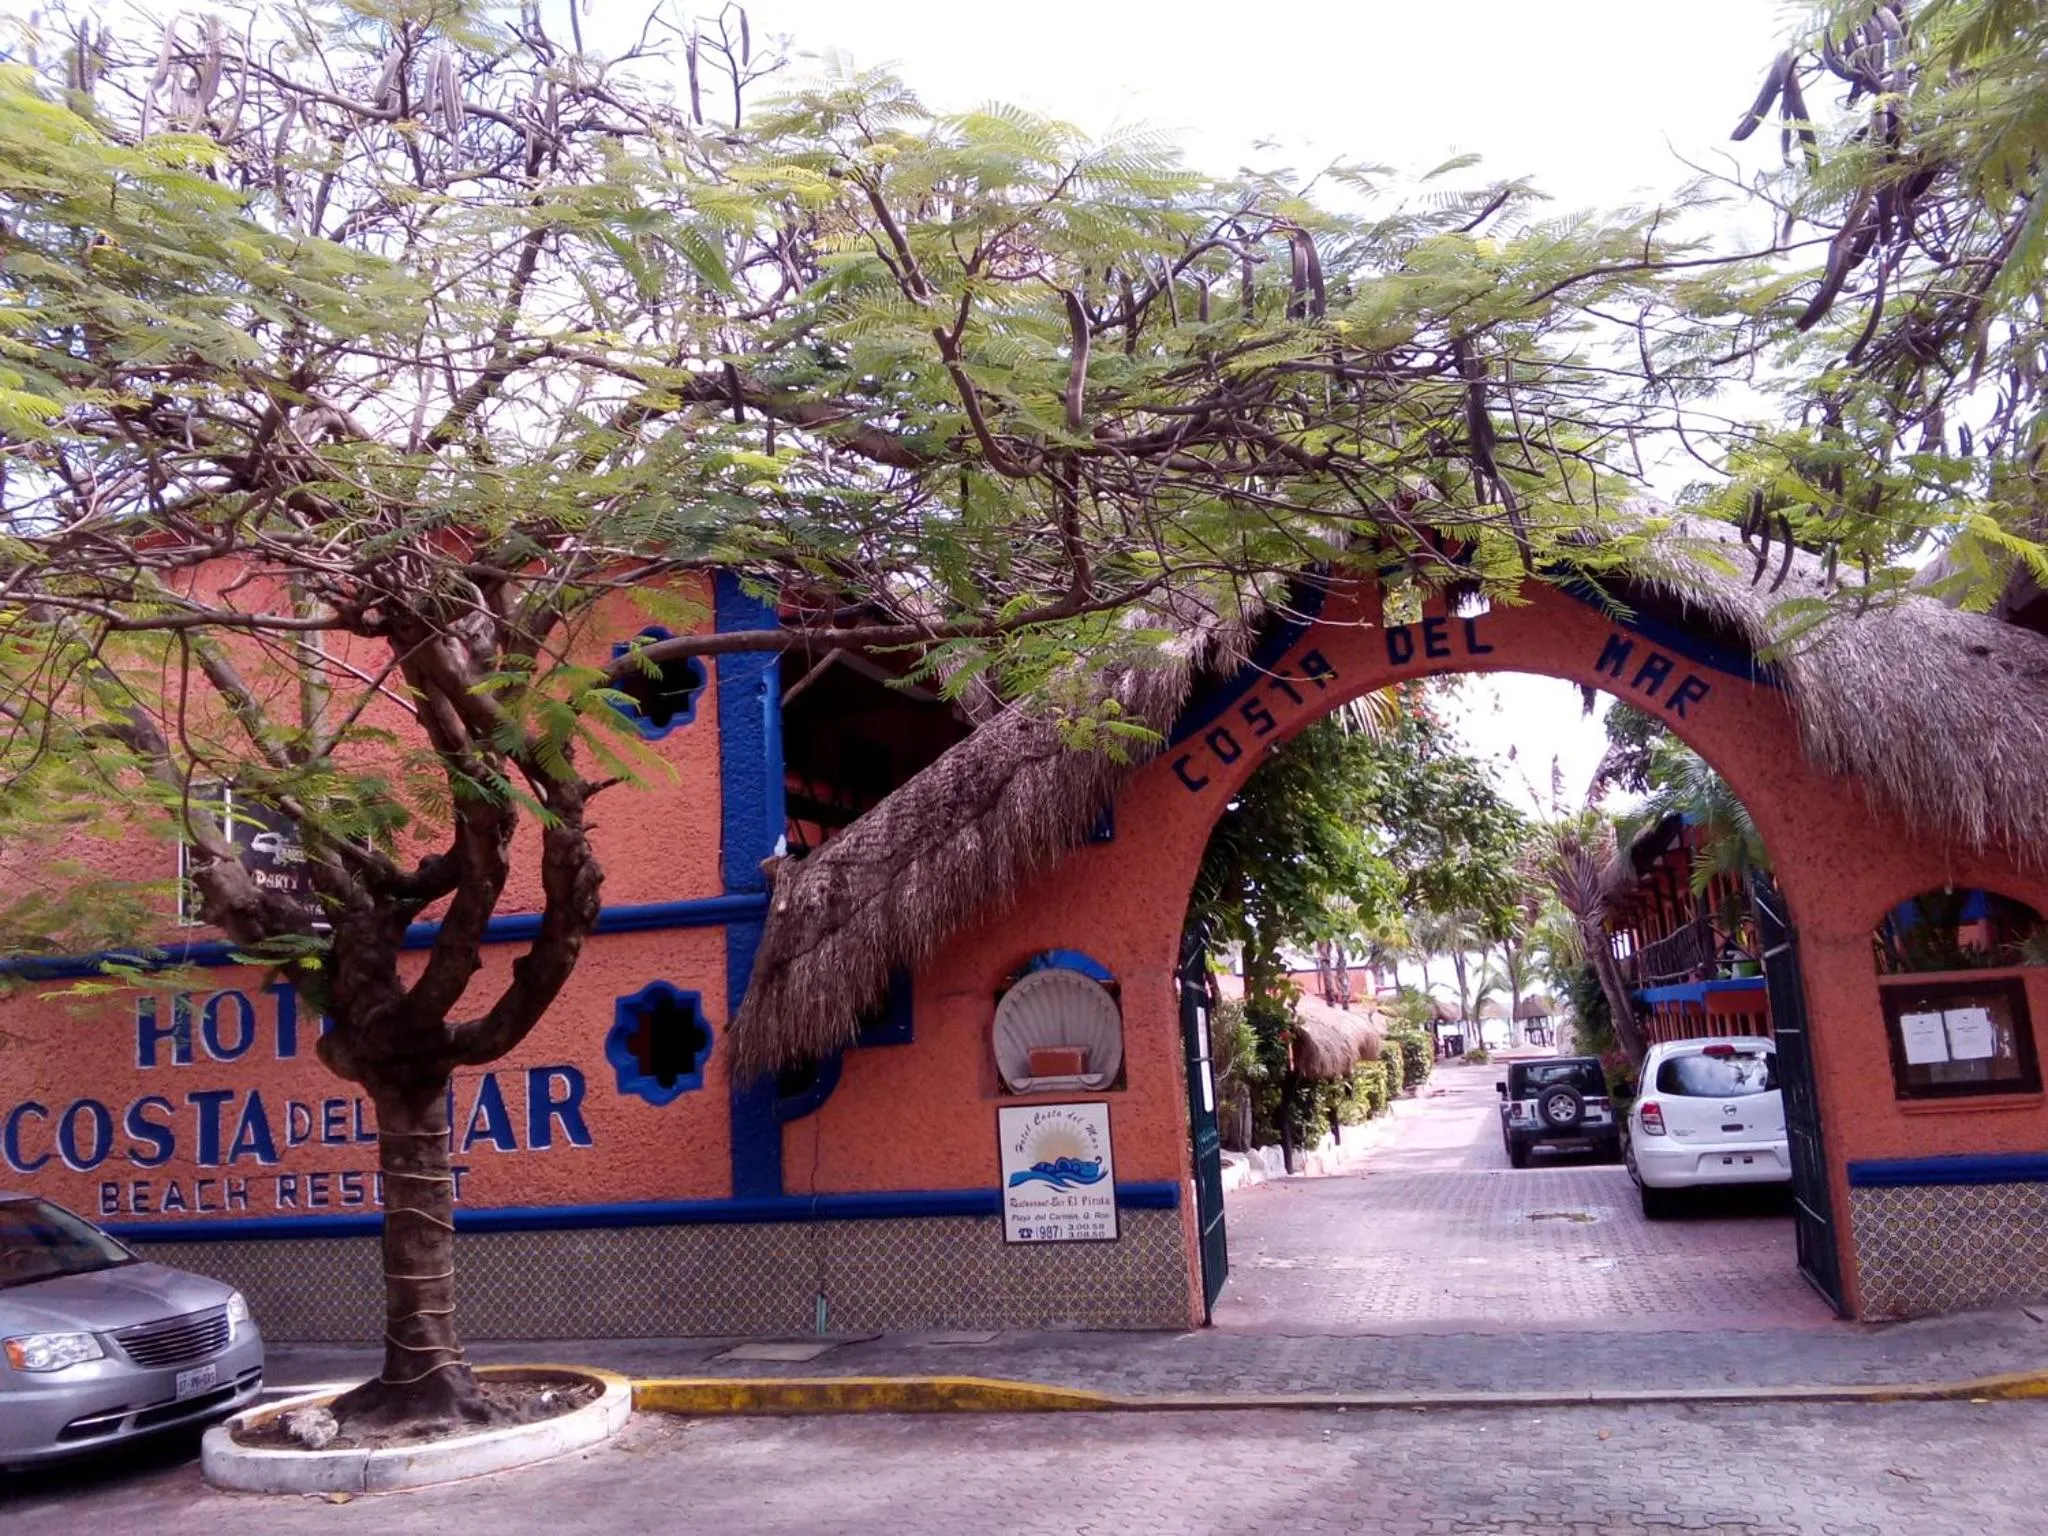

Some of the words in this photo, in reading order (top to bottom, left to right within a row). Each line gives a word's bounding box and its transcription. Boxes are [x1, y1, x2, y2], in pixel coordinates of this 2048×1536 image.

[1172, 649, 1339, 794] COSTA
[1384, 616, 1495, 666] DEL
[1592, 632, 1712, 720] MAR
[2, 1089, 281, 1174] COSTA
[284, 1096, 380, 1149] DEL
[447, 1063, 594, 1156] AR
[1033, 1109, 1062, 1126] Costa
[1067, 1111, 1085, 1125] del
[1085, 1123, 1100, 1150] Mar
[99, 1175, 249, 1217] BEACH
[275, 1164, 472, 1212] REST
[1035, 1212, 1047, 1222] del
[1035, 1225, 1063, 1239] (987)
